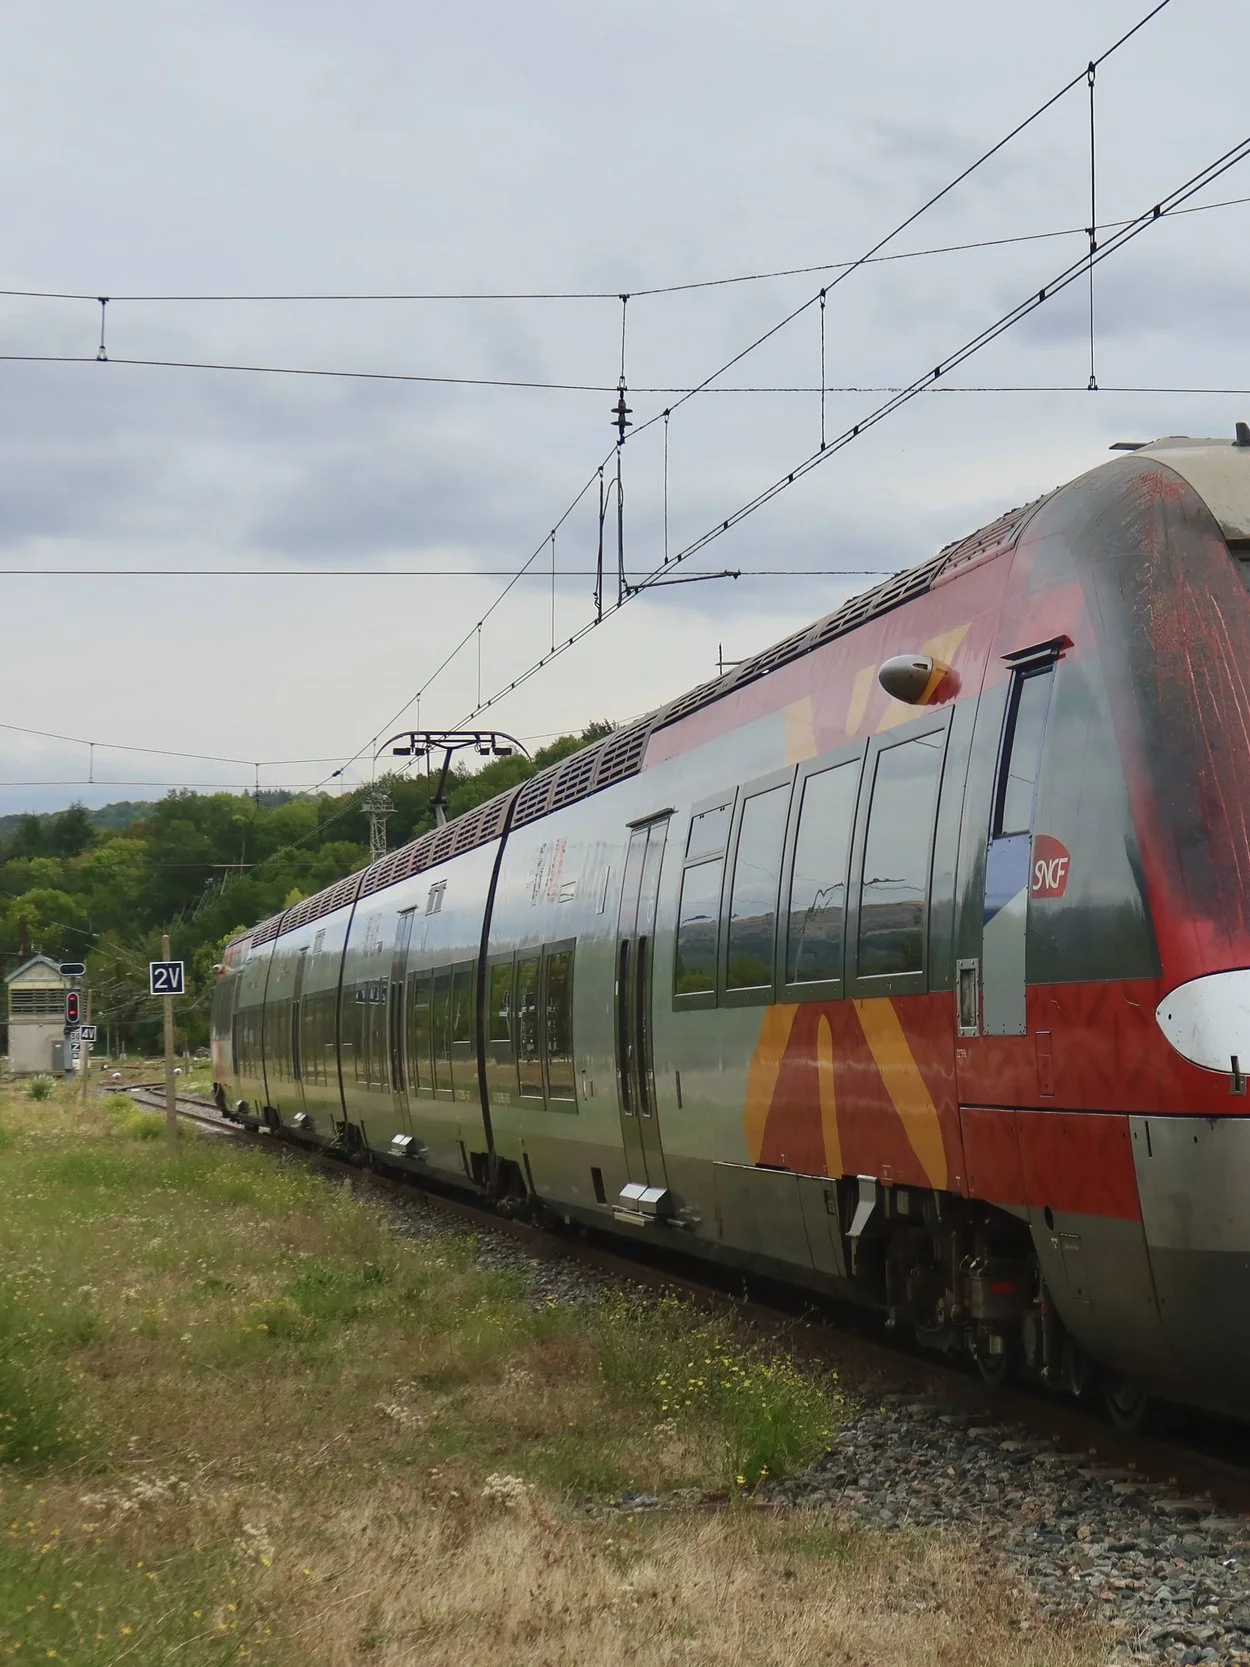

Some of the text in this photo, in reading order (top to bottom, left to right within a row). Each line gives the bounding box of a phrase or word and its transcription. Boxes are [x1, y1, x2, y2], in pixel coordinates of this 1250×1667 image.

[1032, 857, 1068, 890] SNCF
[154, 967, 180, 989] 2V
[82, 1028, 95, 1039] 4V
